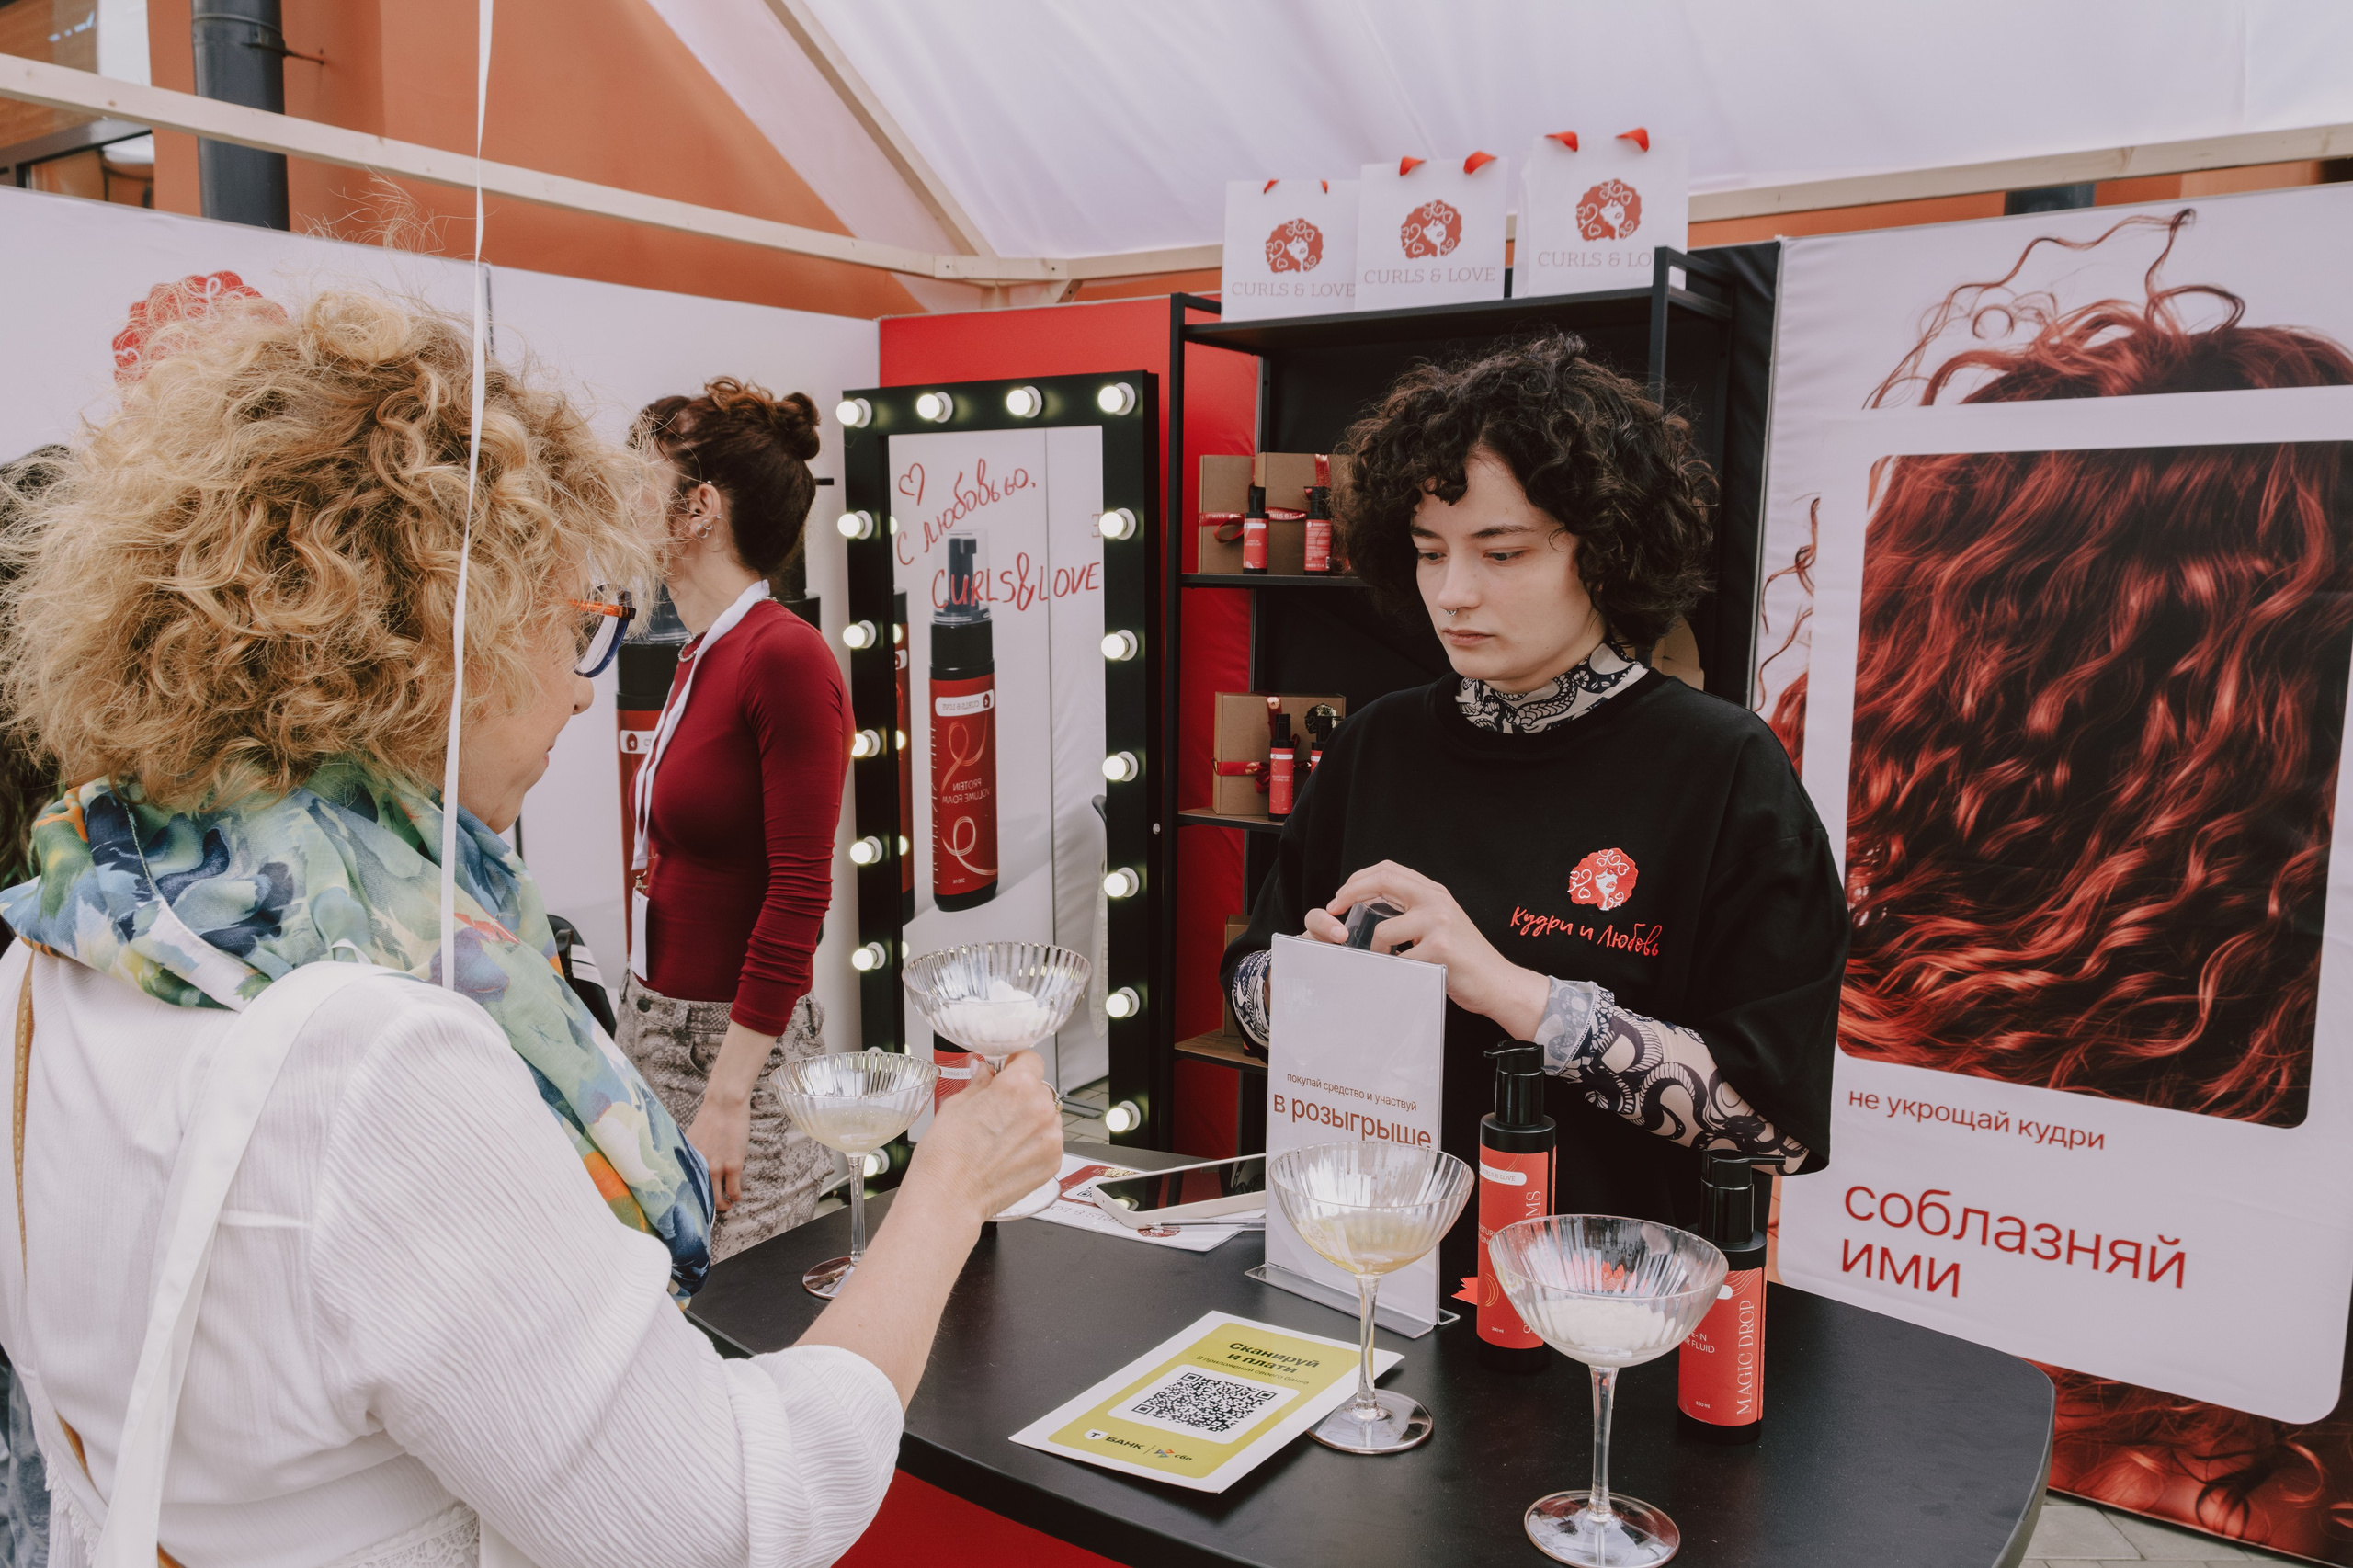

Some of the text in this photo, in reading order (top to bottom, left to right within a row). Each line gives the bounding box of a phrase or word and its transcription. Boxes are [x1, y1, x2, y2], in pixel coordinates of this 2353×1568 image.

[1538, 251, 1654, 268] CURLS & LO
[1364, 267, 1496, 285] CURLS & LOVE
[1232, 282, 1356, 299] CURLS & LOVE
[1510, 905, 1574, 937] Кудри
[1579, 925, 1595, 941] и
[1287, 1072, 1417, 1112] покупай средство и участвуй
[1274, 1094, 1432, 1149] в розыгрыше
[1848, 1089, 2106, 1152] не укрощай кудри
[1499, 1173, 1517, 1182] LOVE
[1844, 1185, 2187, 1290] соблазняй
[1841, 1238, 1961, 1300] ими
[1690, 1330, 1707, 1342] E-IN
[1229, 1342, 1321, 1369] Сканируй
[1691, 1339, 1715, 1354] FLUID
[1203, 1356, 1254, 1373] приложении
[1242, 1356, 1299, 1374] плати
[1736, 1300, 1755, 1416] MAGIC DROP
[1105, 1436, 1145, 1450] БАНК
